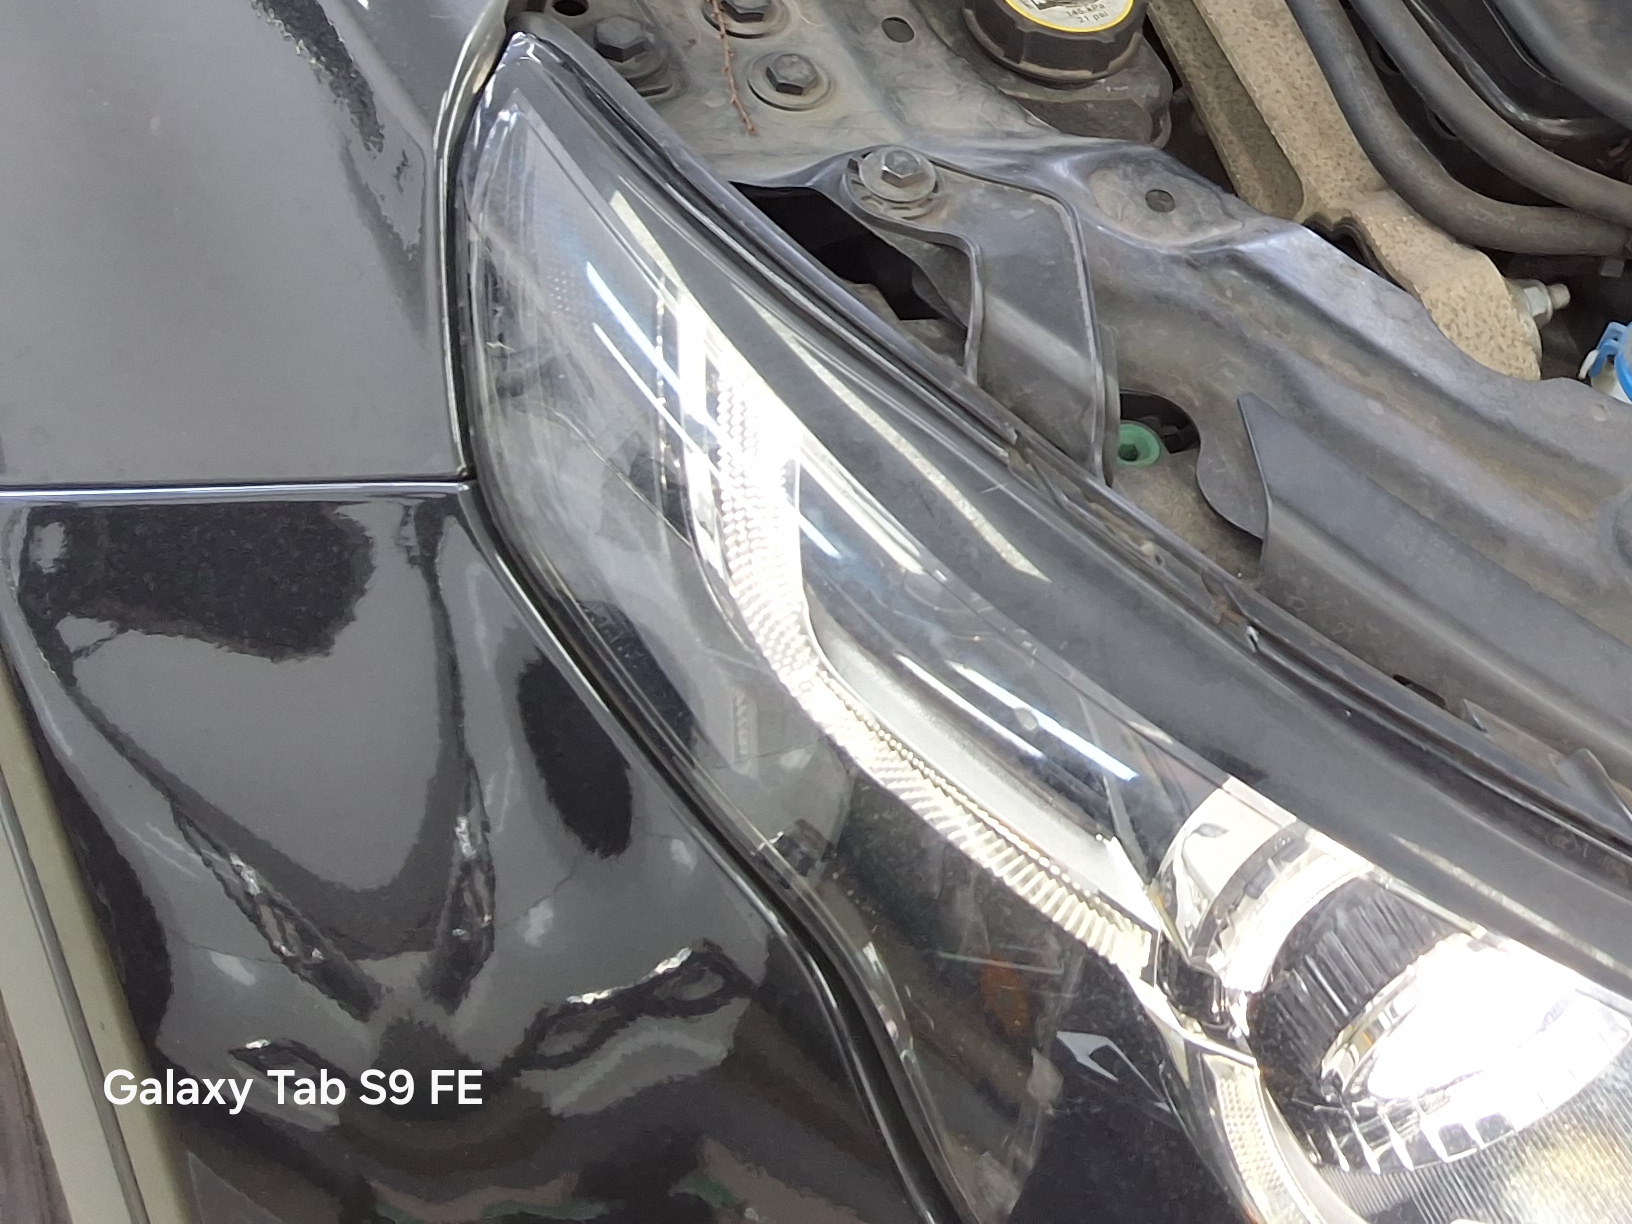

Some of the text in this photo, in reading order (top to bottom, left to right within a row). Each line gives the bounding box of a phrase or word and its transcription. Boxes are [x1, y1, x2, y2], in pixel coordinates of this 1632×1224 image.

[1086, 3, 1105, 13] kPa
[1076, 11, 1109, 24] 21 psi
